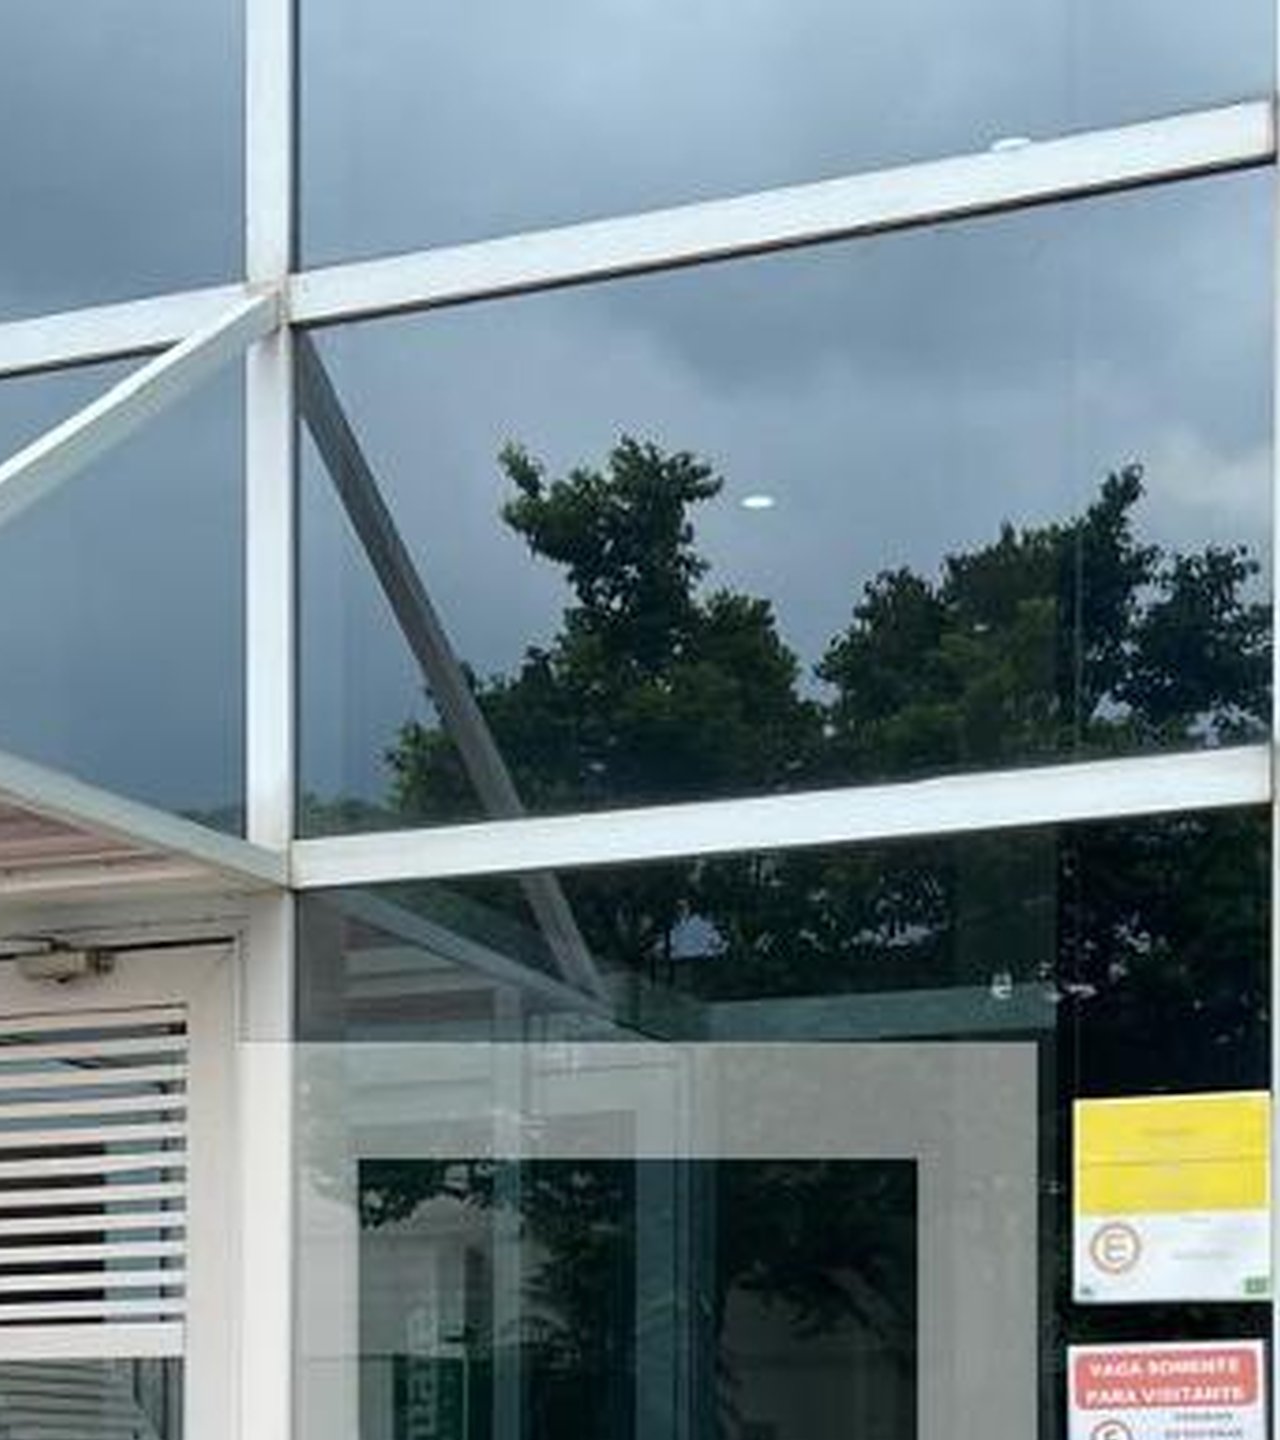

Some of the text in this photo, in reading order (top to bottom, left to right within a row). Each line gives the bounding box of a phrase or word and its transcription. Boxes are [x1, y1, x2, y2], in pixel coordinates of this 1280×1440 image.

[1089, 1356, 1241, 1379] VAGA SOMENTE
[1085, 1385, 1245, 1406] PARA VISITANTE
